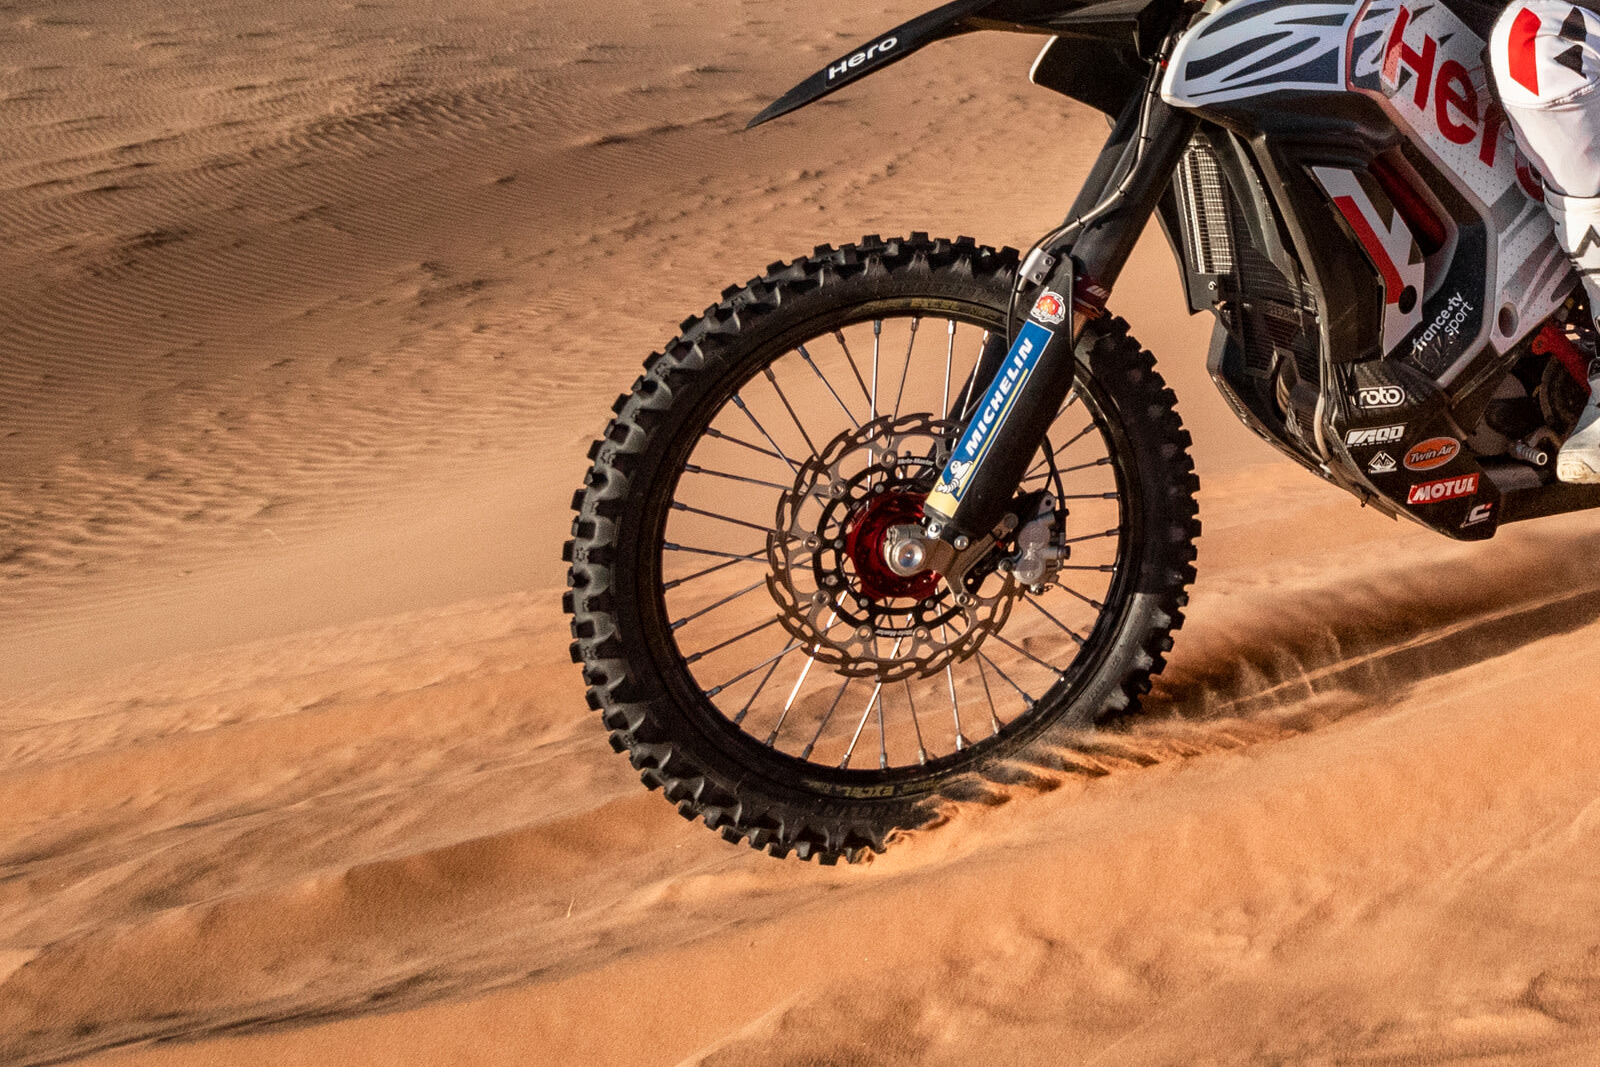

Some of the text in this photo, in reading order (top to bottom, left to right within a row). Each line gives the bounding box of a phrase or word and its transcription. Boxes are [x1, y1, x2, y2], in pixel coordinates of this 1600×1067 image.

[828, 36, 898, 80] Hero
[1444, 301, 1474, 336] sport
[964, 337, 1033, 456] MICHELIN
[1360, 386, 1401, 406] roto
[1410, 444, 1456, 465] Twin Air
[1413, 477, 1475, 502] MOTUL
